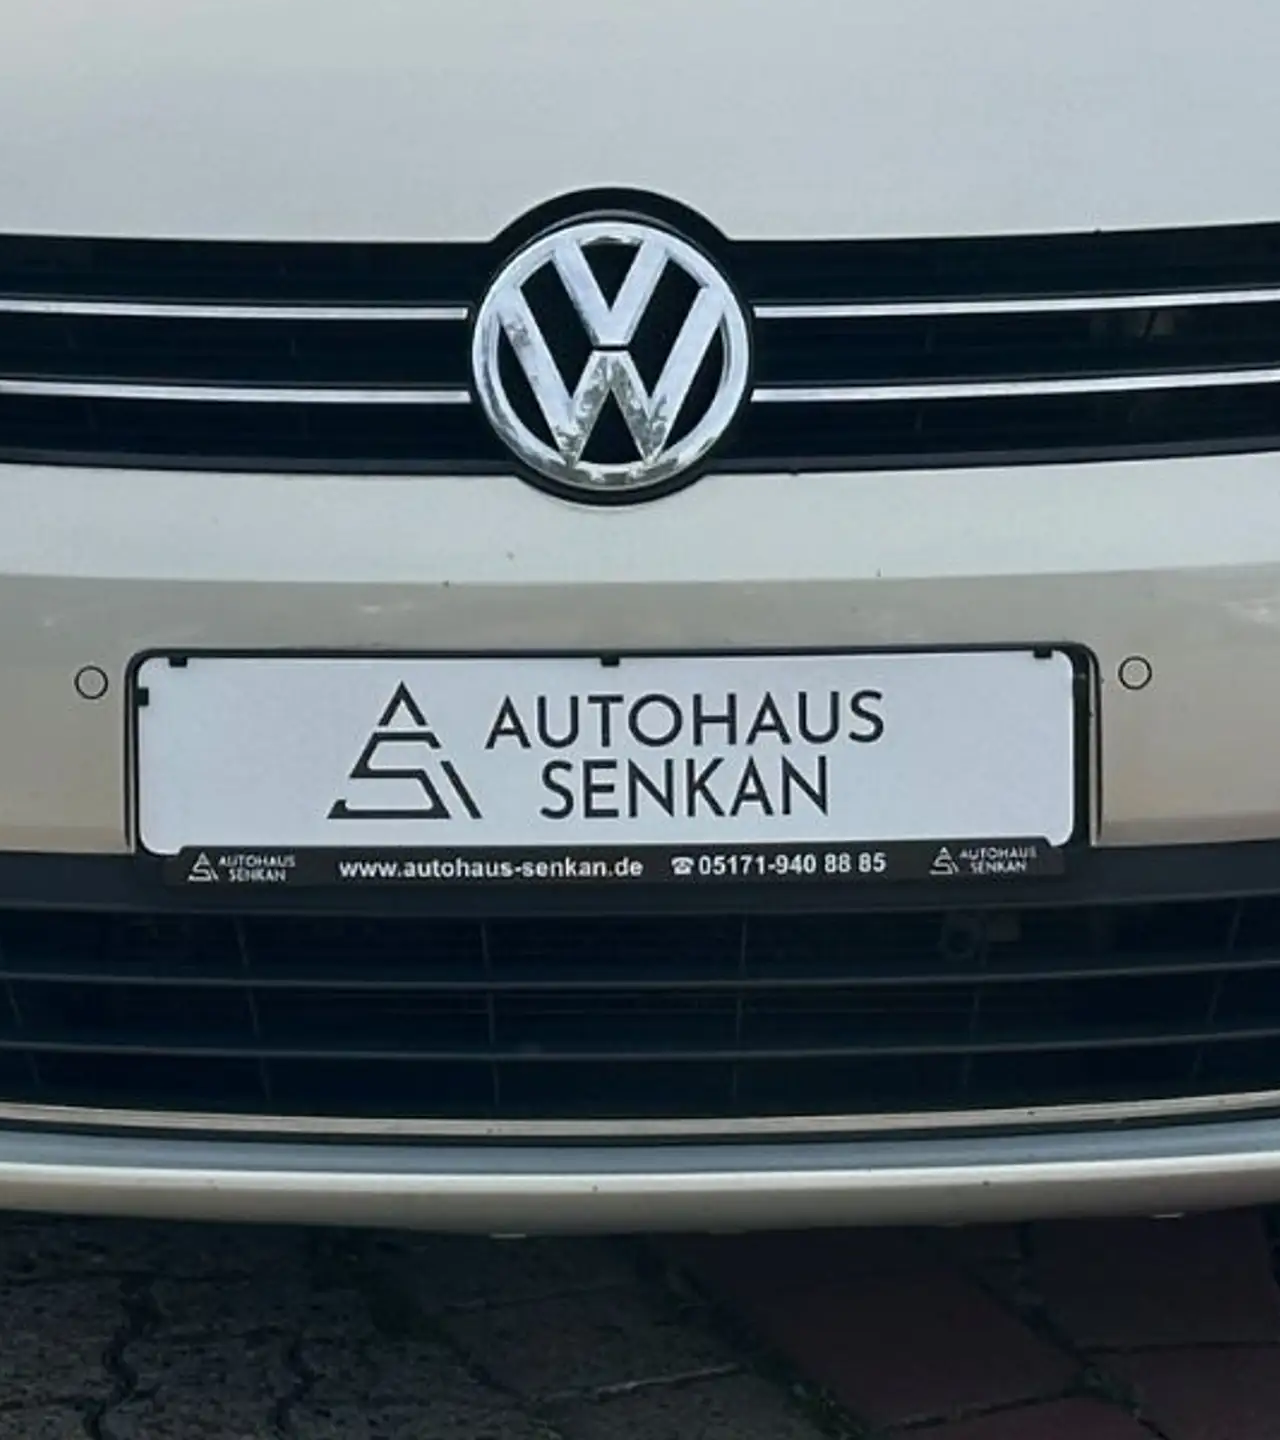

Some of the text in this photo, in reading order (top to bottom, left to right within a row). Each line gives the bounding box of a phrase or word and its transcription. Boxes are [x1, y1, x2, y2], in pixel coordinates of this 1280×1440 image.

[484, 689, 885, 750] AUTOHAUS
[539, 754, 829, 820] SENKAN
[218, 854, 297, 869] AUTOHAUS
[958, 845, 1038, 860] AUTOHAUS
[338, 857, 645, 880] www.autohaus-senkan.de
[697, 852, 887, 876] 05171-940 88 85
[969, 859, 1028, 875] SENKAN
[228, 867, 287, 883] SENKAN
